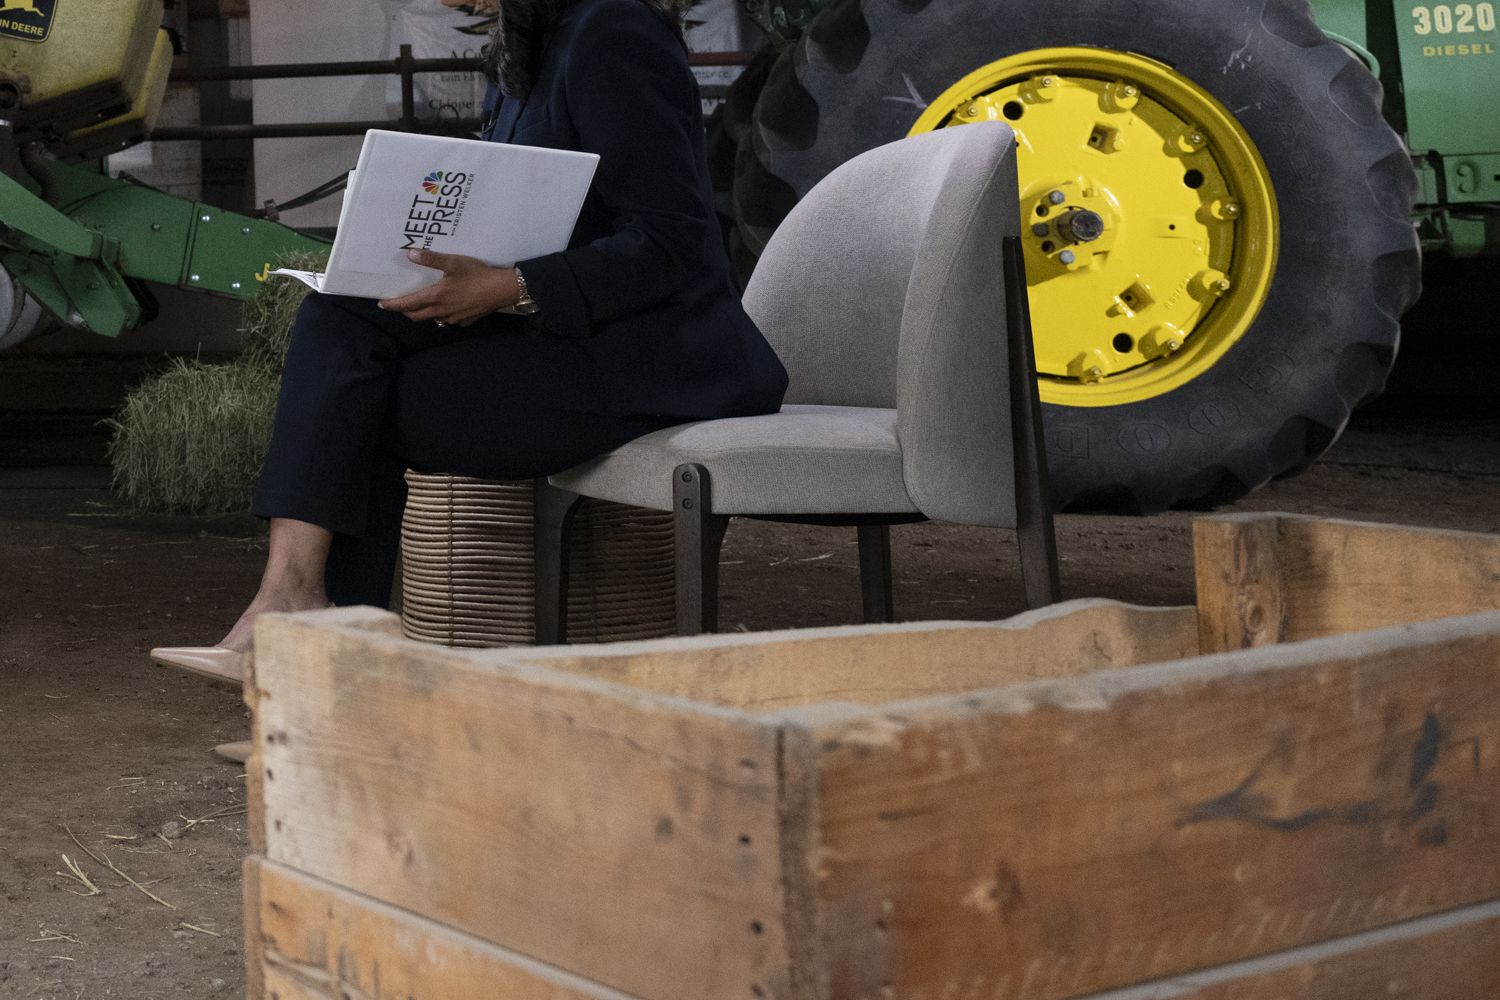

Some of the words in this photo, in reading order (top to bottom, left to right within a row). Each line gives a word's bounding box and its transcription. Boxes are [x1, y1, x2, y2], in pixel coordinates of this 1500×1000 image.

[11, 21, 45, 37] DEERE
[1412, 2, 1496, 35] 3020
[1423, 43, 1494, 57] DIESEL
[399, 194, 434, 249] MEET
[427, 171, 466, 236] PRESS
[453, 201, 466, 227] KRISTEN
[462, 173, 475, 199] WELKER
[422, 236, 434, 250] THE
[1047, 352, 1297, 460] GOOD
